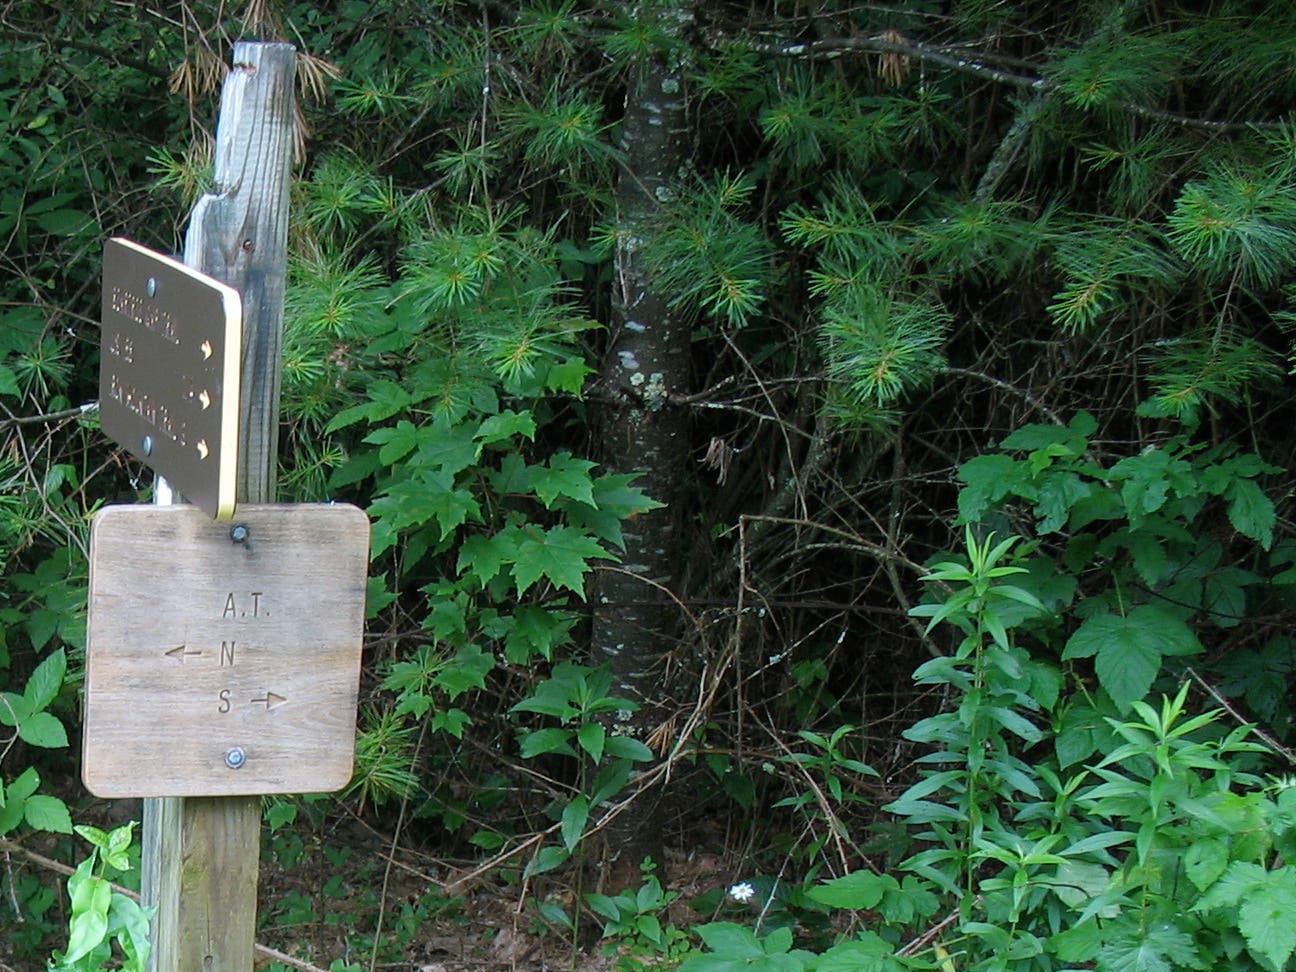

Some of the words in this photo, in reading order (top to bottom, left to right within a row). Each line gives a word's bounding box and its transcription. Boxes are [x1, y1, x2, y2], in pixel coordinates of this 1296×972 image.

[222, 591, 270, 618] A.T.
[220, 640, 236, 667] N
[218, 688, 232, 714] S
